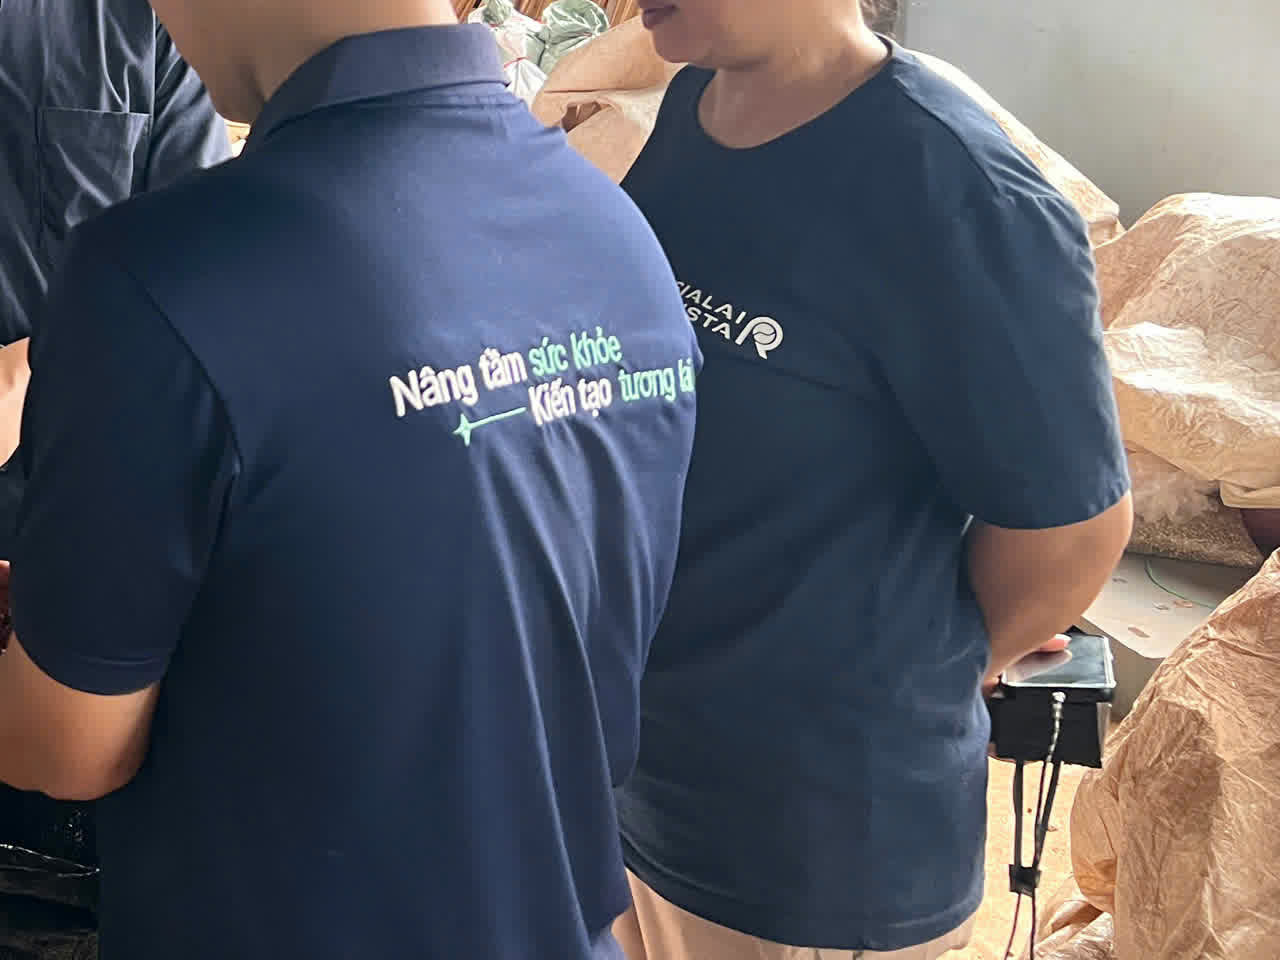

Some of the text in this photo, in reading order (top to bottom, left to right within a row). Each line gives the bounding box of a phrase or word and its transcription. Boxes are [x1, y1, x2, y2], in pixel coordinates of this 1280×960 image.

[389, 325, 623, 417] Nâng tầm sức khỏe
[528, 377, 577, 427] Kiến
[577, 377, 613, 417] tạo
